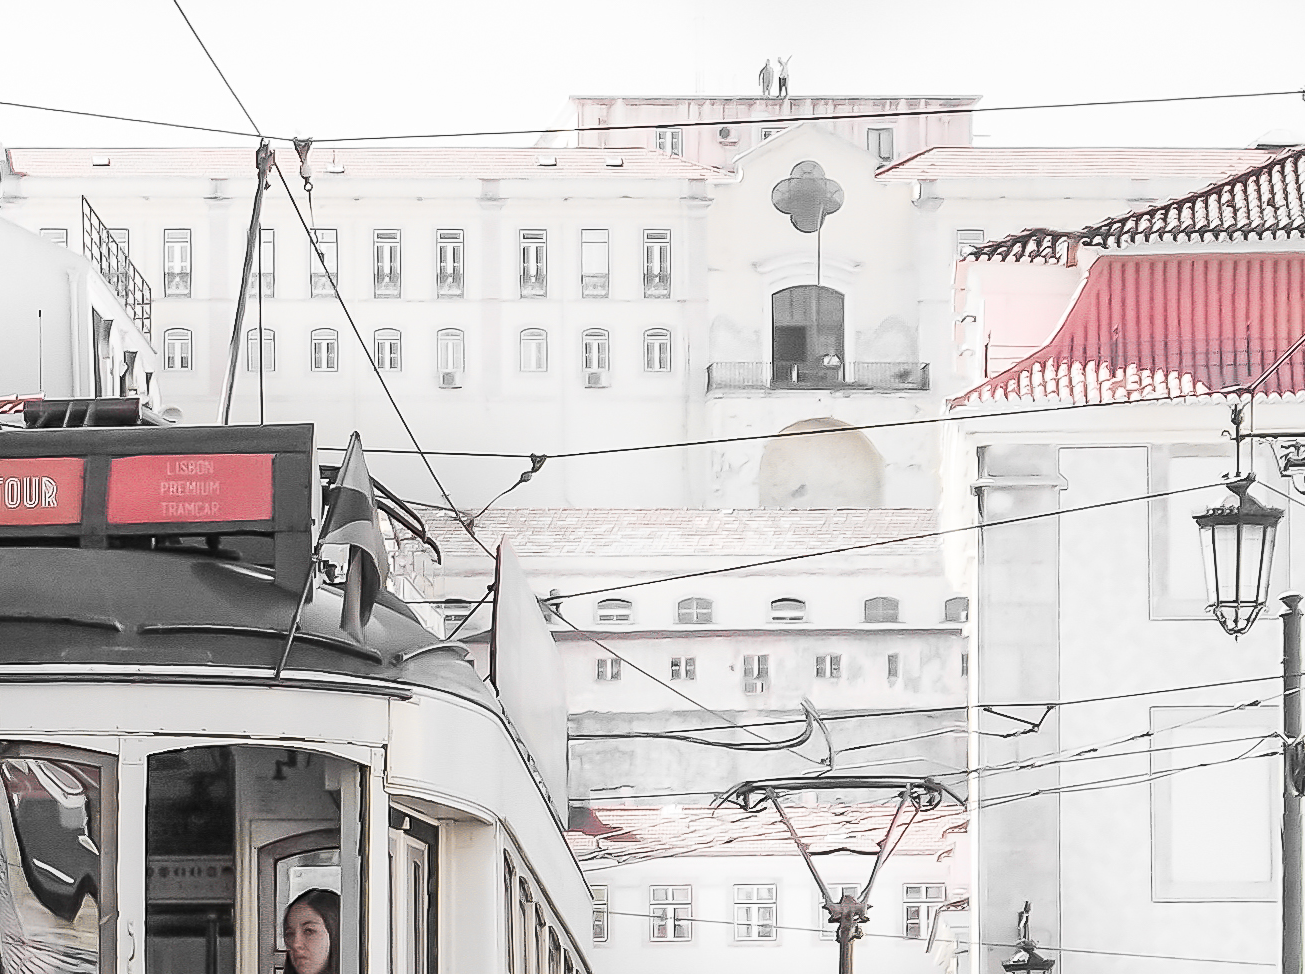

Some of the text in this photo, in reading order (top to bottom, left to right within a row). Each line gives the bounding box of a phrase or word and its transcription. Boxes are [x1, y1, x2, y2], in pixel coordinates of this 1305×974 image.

[166, 460, 215, 476] LISBON
[160, 480, 221, 496] PREMIUM
[161, 501, 220, 517] TRAMCAR
